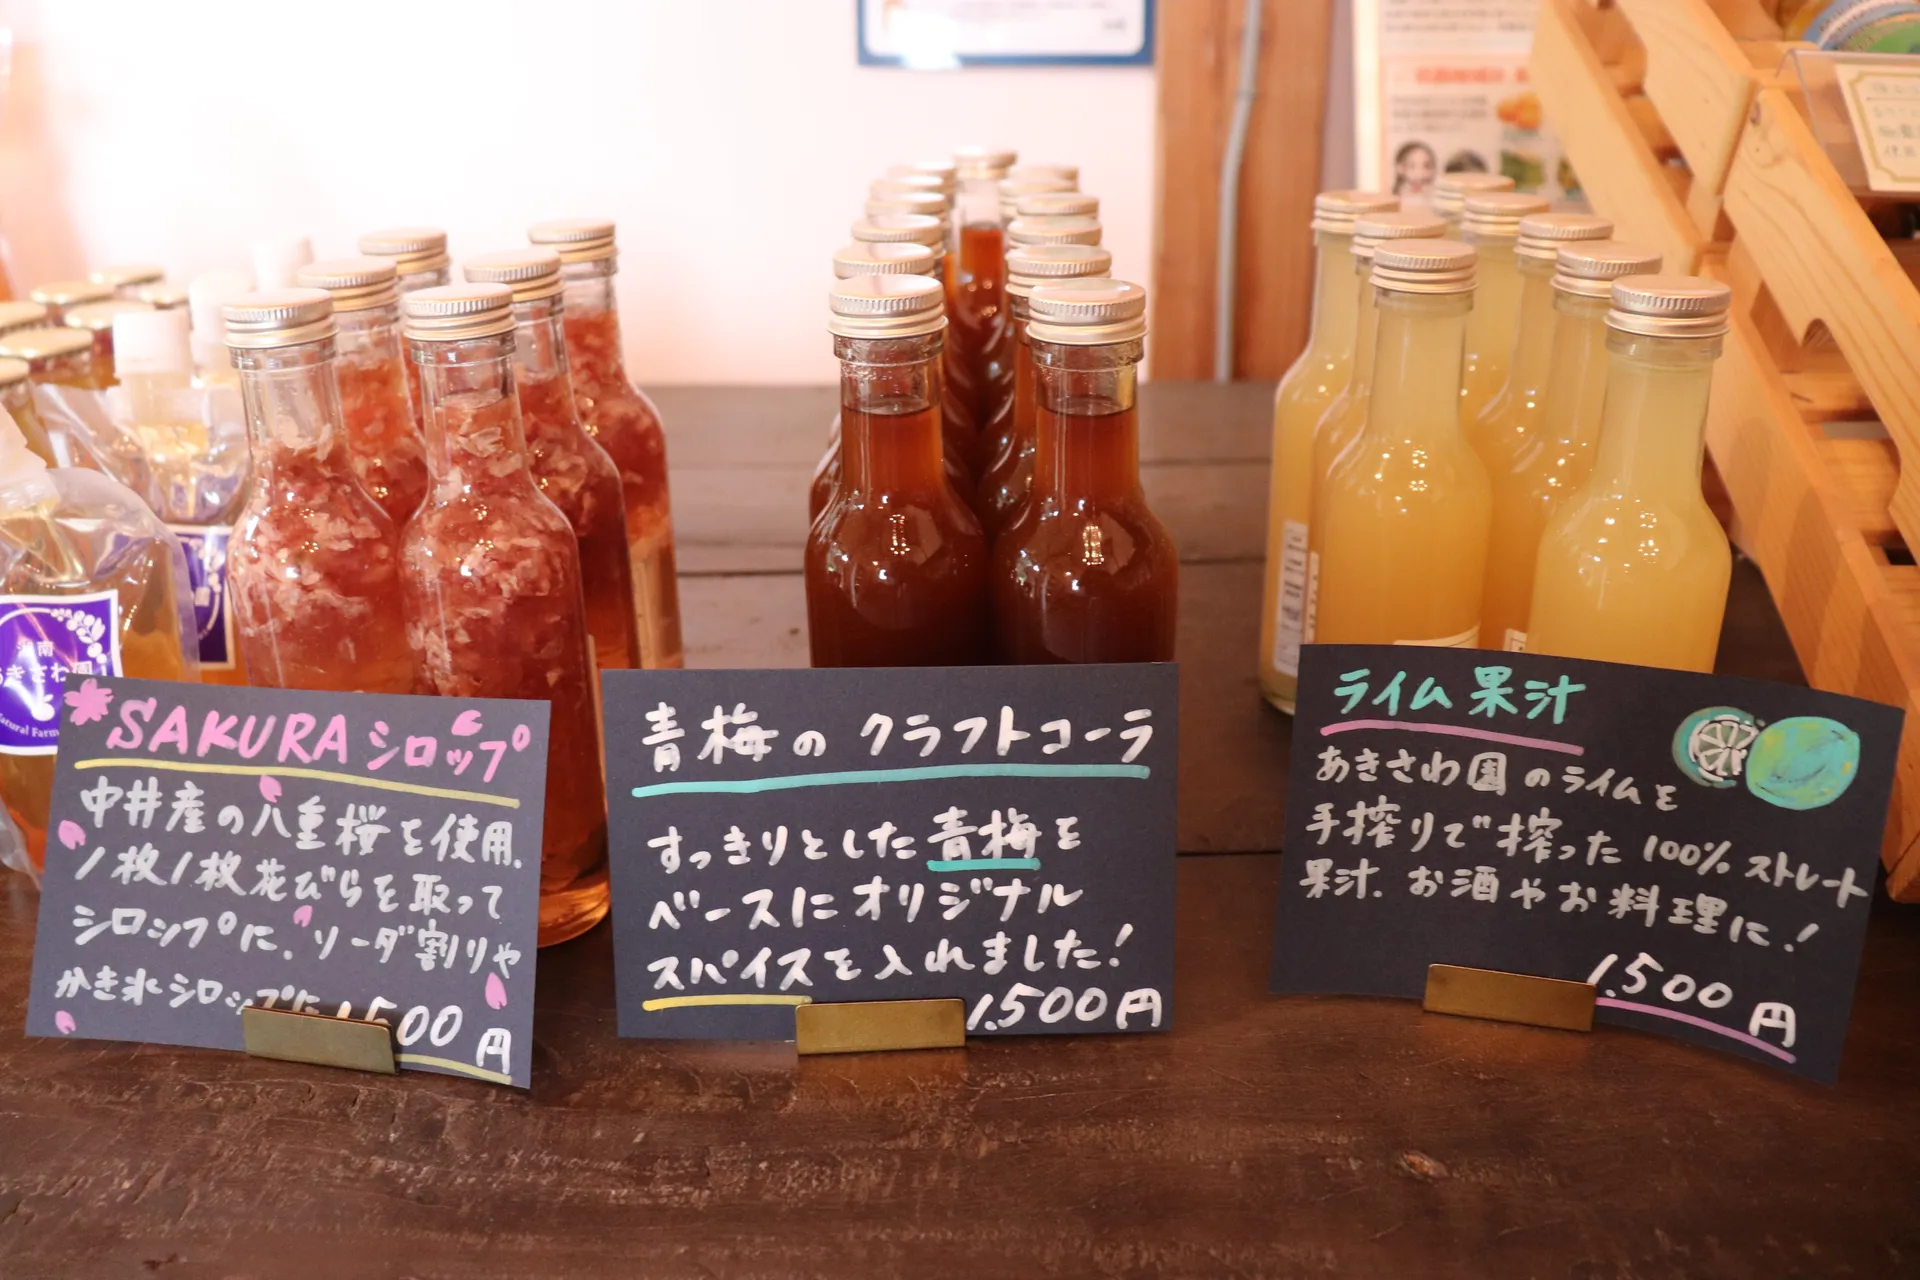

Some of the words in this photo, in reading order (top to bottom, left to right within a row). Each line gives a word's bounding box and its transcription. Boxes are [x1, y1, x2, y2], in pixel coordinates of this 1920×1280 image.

[0, 661, 92, 684] きさわ園
[106, 697, 348, 765] SAKURA
[367, 722, 532, 783] シロップ
[642, 702, 826, 772] 青梅の
[860, 705, 1153, 763] クラフトコーラ
[647, 806, 1081, 874] すっきりとした青梅を
[648, 875, 1083, 930] ベースにオリジナル
